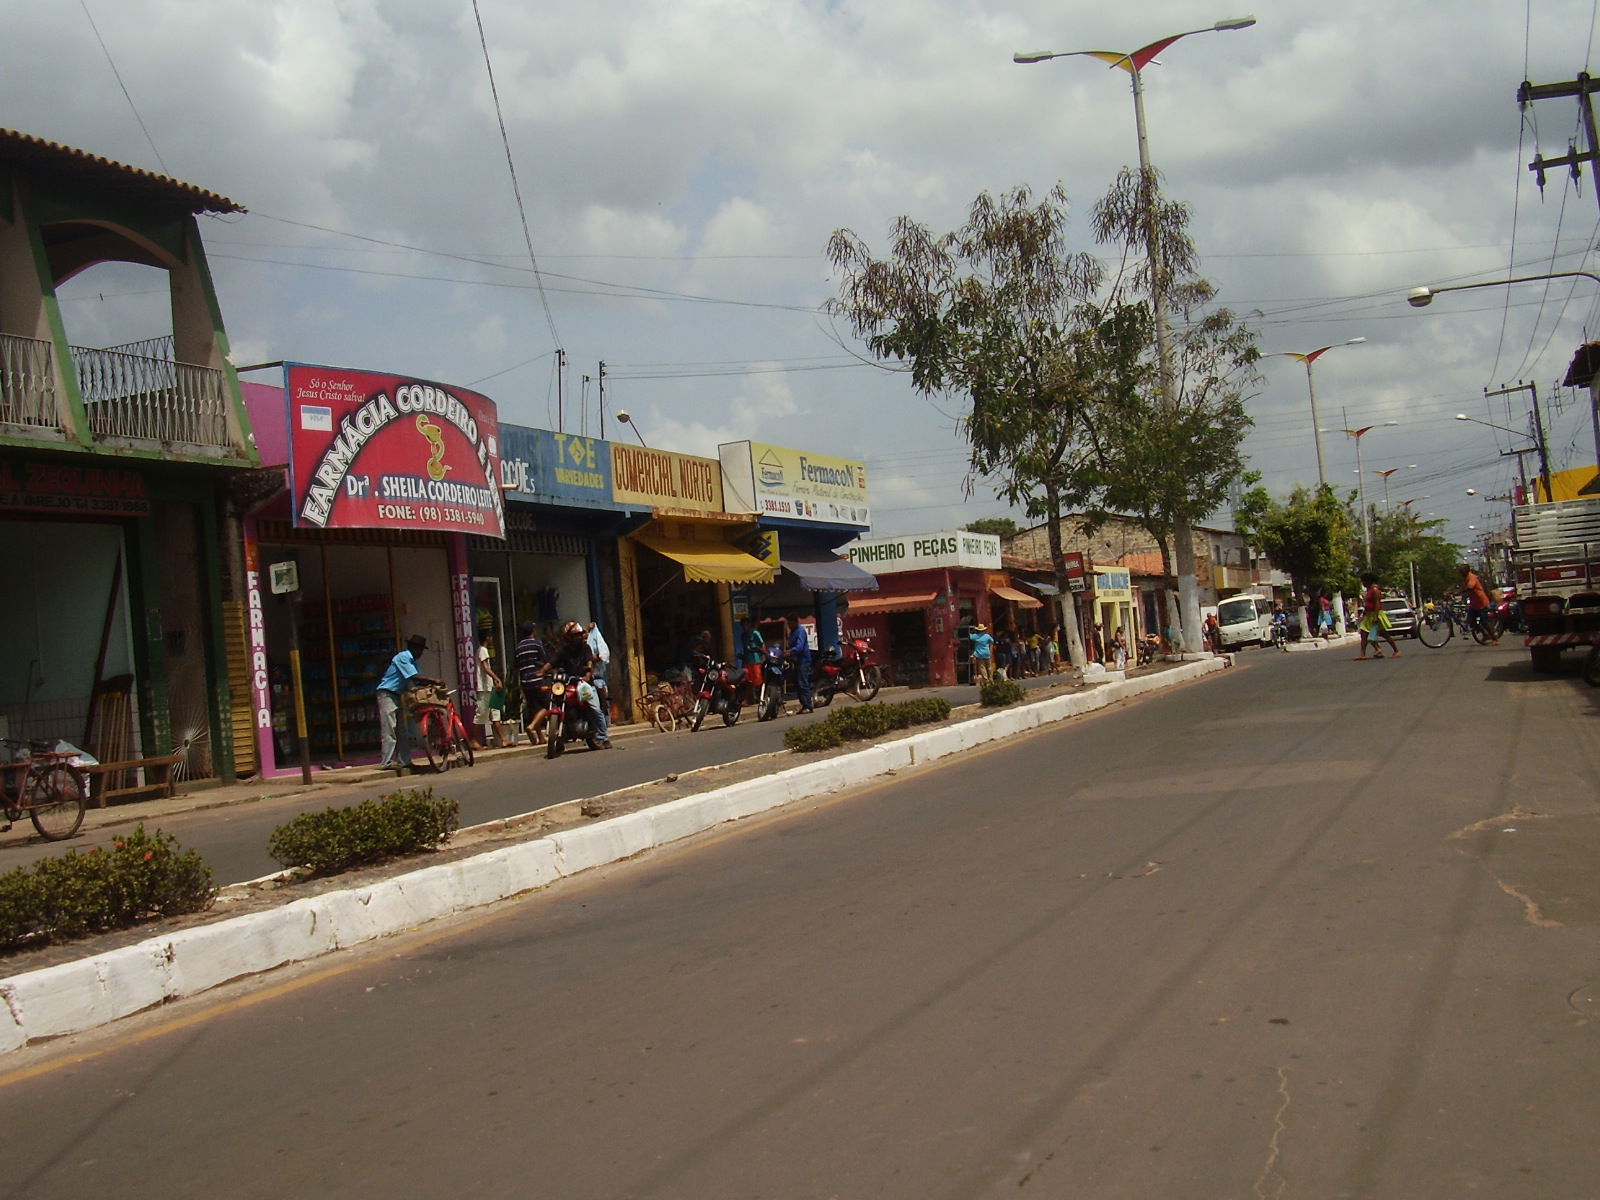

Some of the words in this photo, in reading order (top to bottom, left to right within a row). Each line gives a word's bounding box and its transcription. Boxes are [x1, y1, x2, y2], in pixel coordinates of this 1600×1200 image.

[296, 387, 319, 399] Jesus
[319, 389, 343, 401] Cristo
[309, 377, 321, 389] Só
[328, 379, 355, 392] Senhor
[301, 393, 399, 528] FARMÁCIA
[396, 384, 478, 445] CORDEIRO
[26, 463, 148, 497] ZEQUINHA
[555, 467, 605, 489] VARIEDADES
[383, 476, 428, 499] SHEILA
[428, 481, 477, 506] CORDEIRO
[378, 504, 416, 520] FONE:
[419, 506, 442, 523] (98)
[444, 508, 485, 526] 3381-5940
[849, 542, 906, 564] PINHEIRO
[913, 537, 958, 558] PEÇAS
[846, 627, 877, 639] YAMAHA
[247, 571, 272, 729] FARMÁCIA
